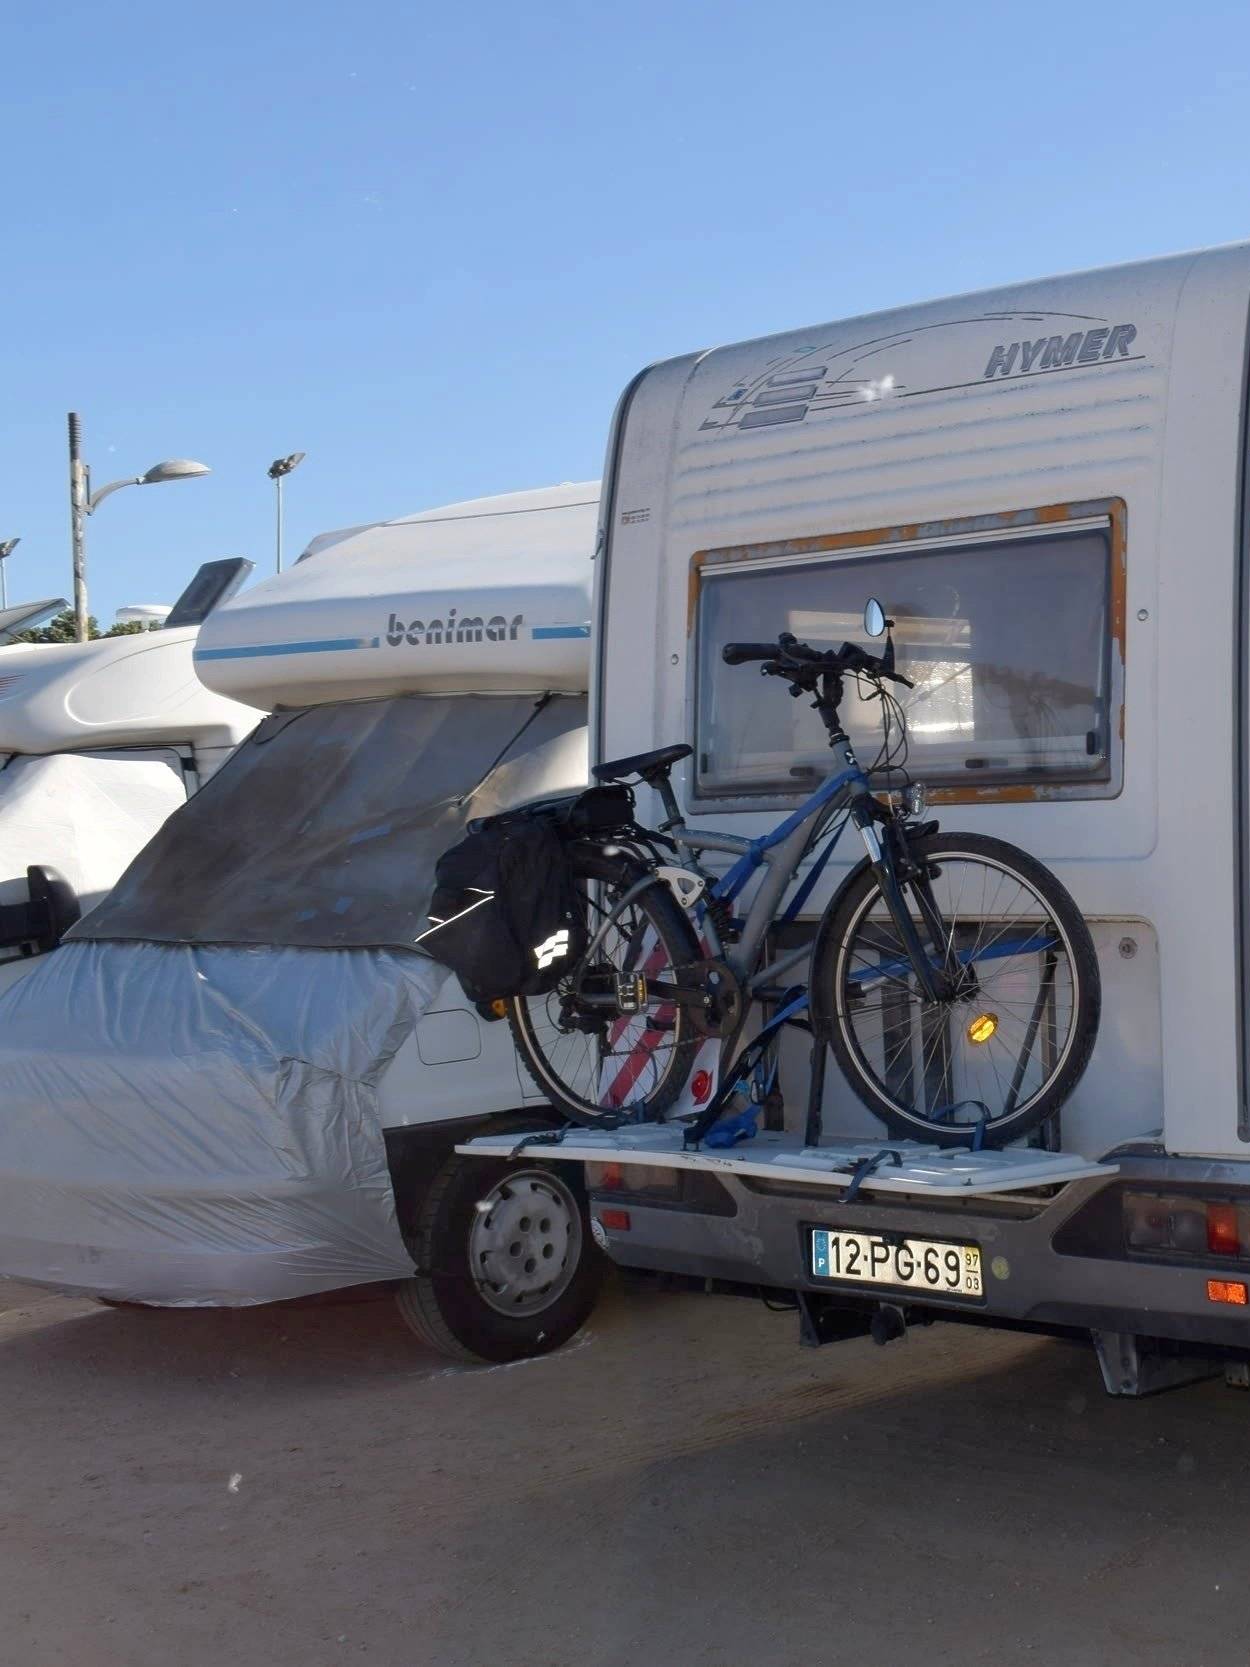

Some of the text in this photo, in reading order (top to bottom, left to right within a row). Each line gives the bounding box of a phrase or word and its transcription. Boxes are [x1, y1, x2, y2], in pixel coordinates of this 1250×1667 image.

[984, 323, 1138, 379] HYMER
[386, 608, 524, 647] benimar
[818, 1258, 825, 1268] P
[965, 1253, 979, 1267] 97
[966, 1276, 980, 1290] 03
